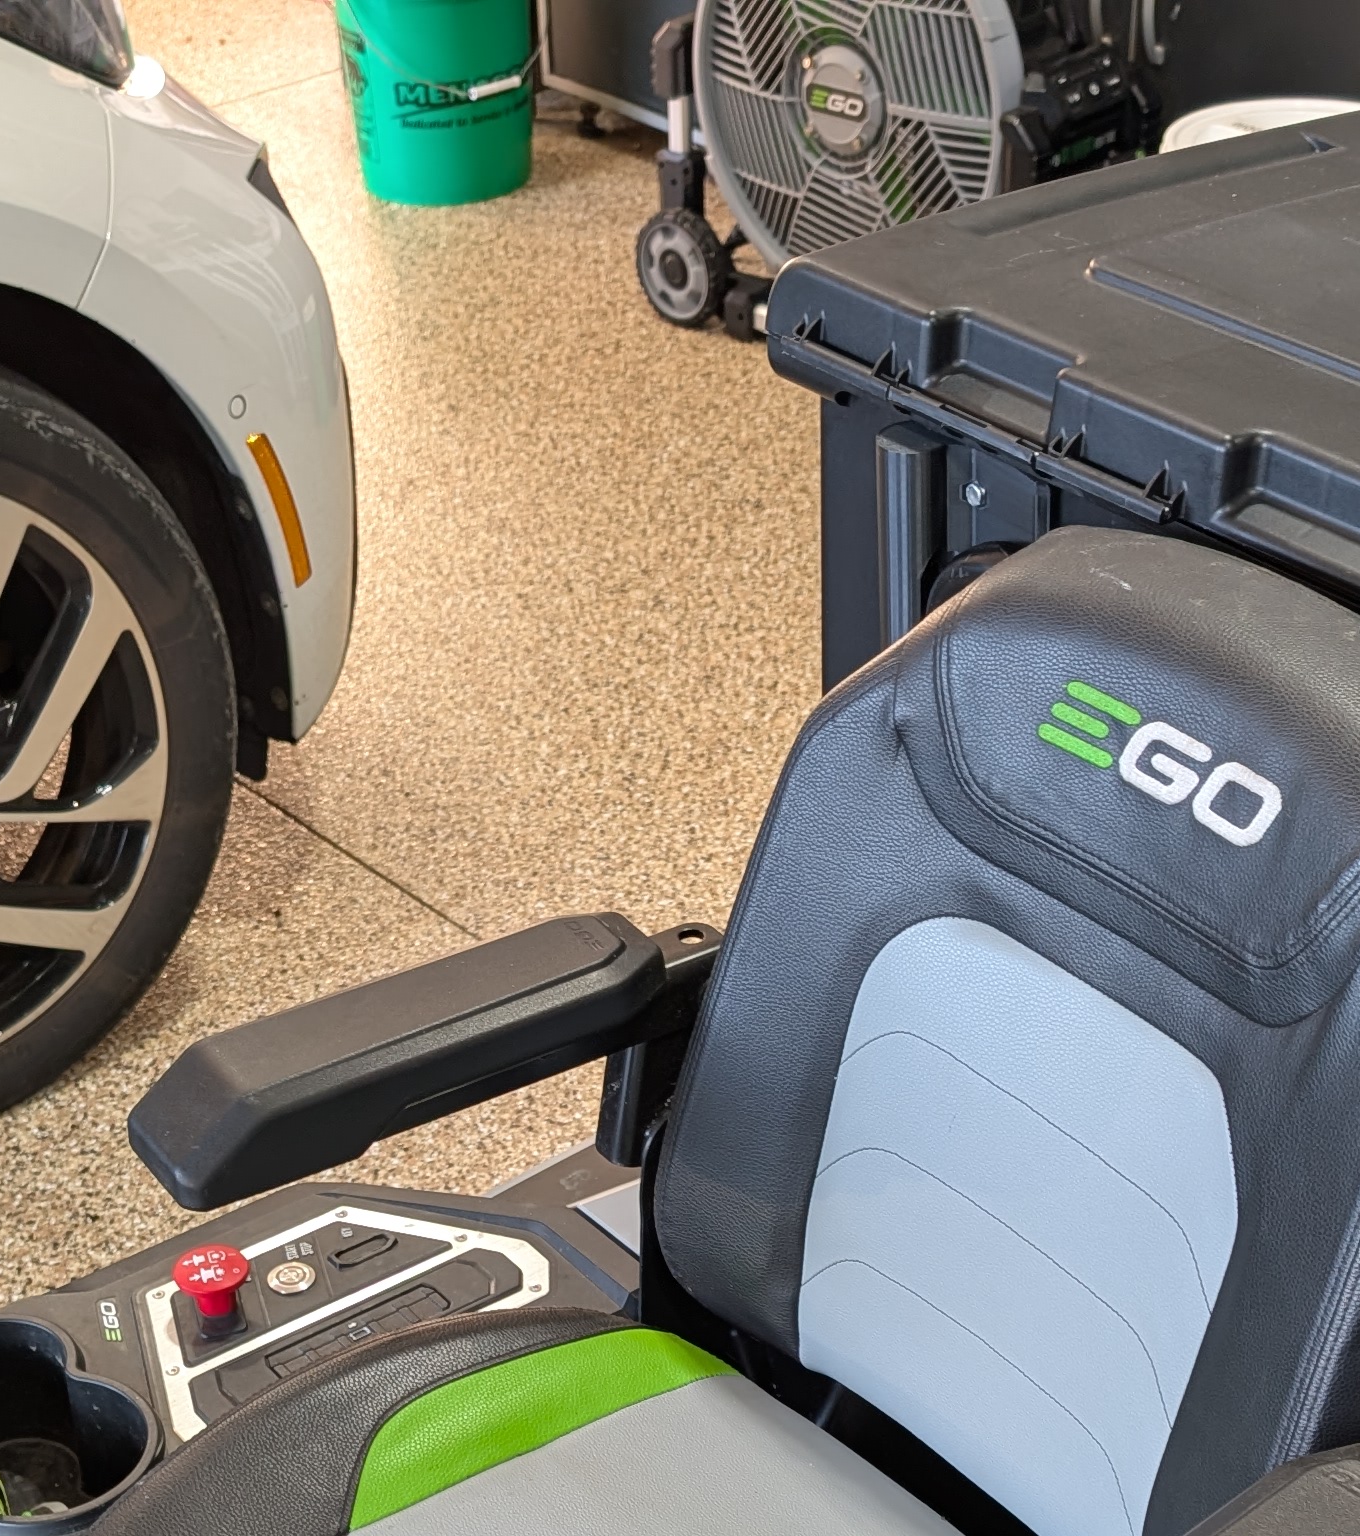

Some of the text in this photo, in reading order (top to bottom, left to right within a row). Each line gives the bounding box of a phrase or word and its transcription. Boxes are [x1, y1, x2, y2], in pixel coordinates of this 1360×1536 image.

[809, 88, 865, 117] EGO
[1038, 681, 1282, 847] EGO
[100, 1301, 122, 1343] EGO
